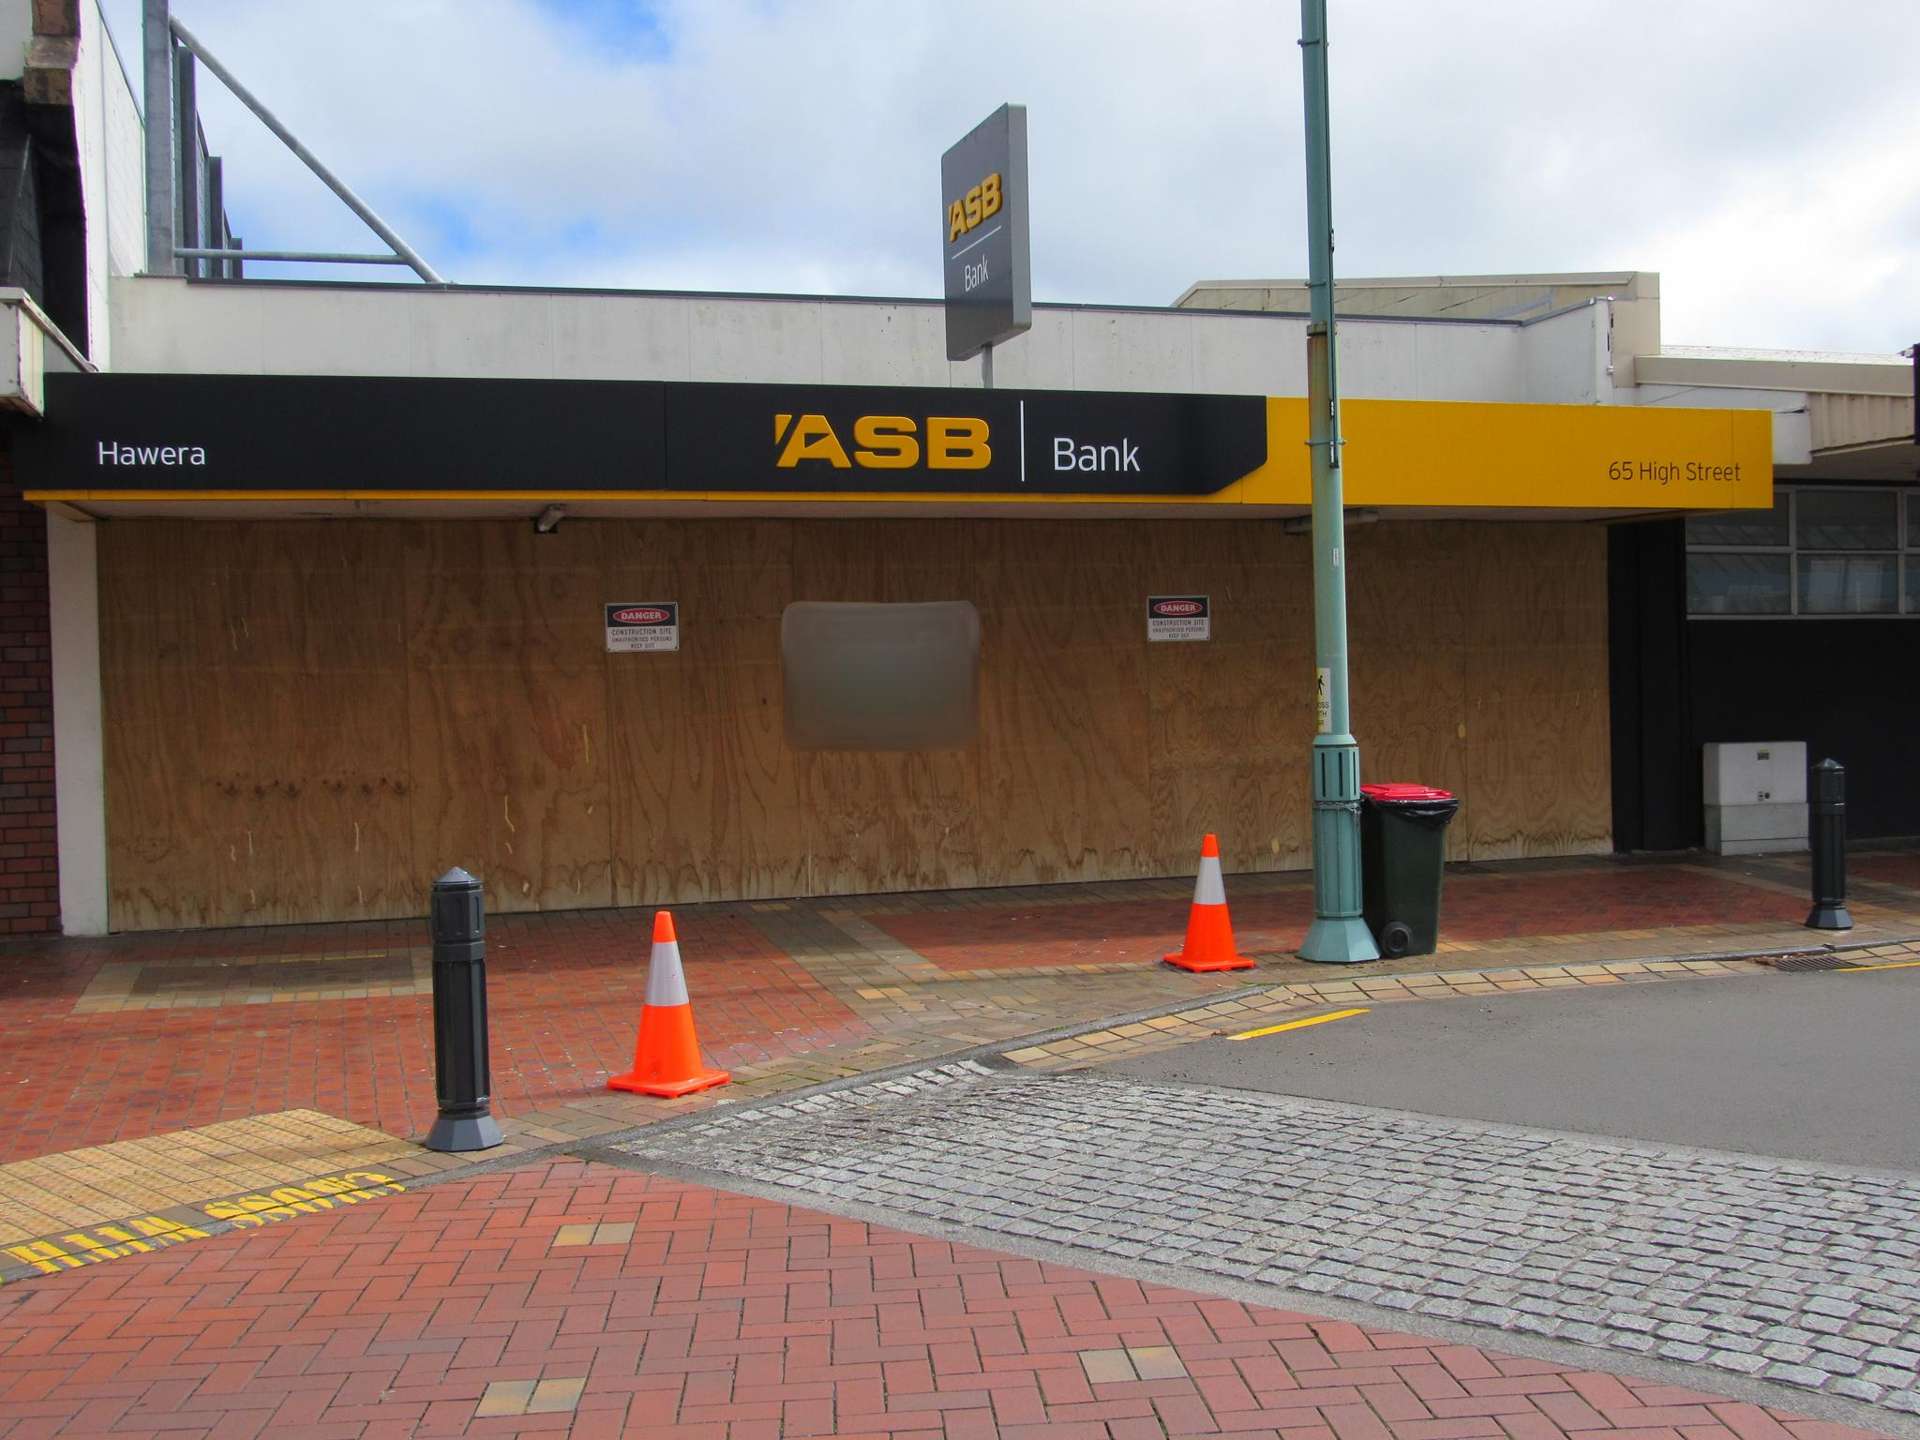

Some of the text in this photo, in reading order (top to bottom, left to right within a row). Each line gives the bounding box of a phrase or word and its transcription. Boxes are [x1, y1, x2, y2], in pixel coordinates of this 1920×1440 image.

[949, 172, 1003, 243] ASB
[964, 254, 989, 293] Bank
[98, 441, 206, 466] Hawera
[775, 414, 1141, 472] ASB Bank
[1608, 461, 1742, 485] 65 High Street
[620, 611, 662, 620] DANGER
[1160, 604, 1197, 612] DANGER
